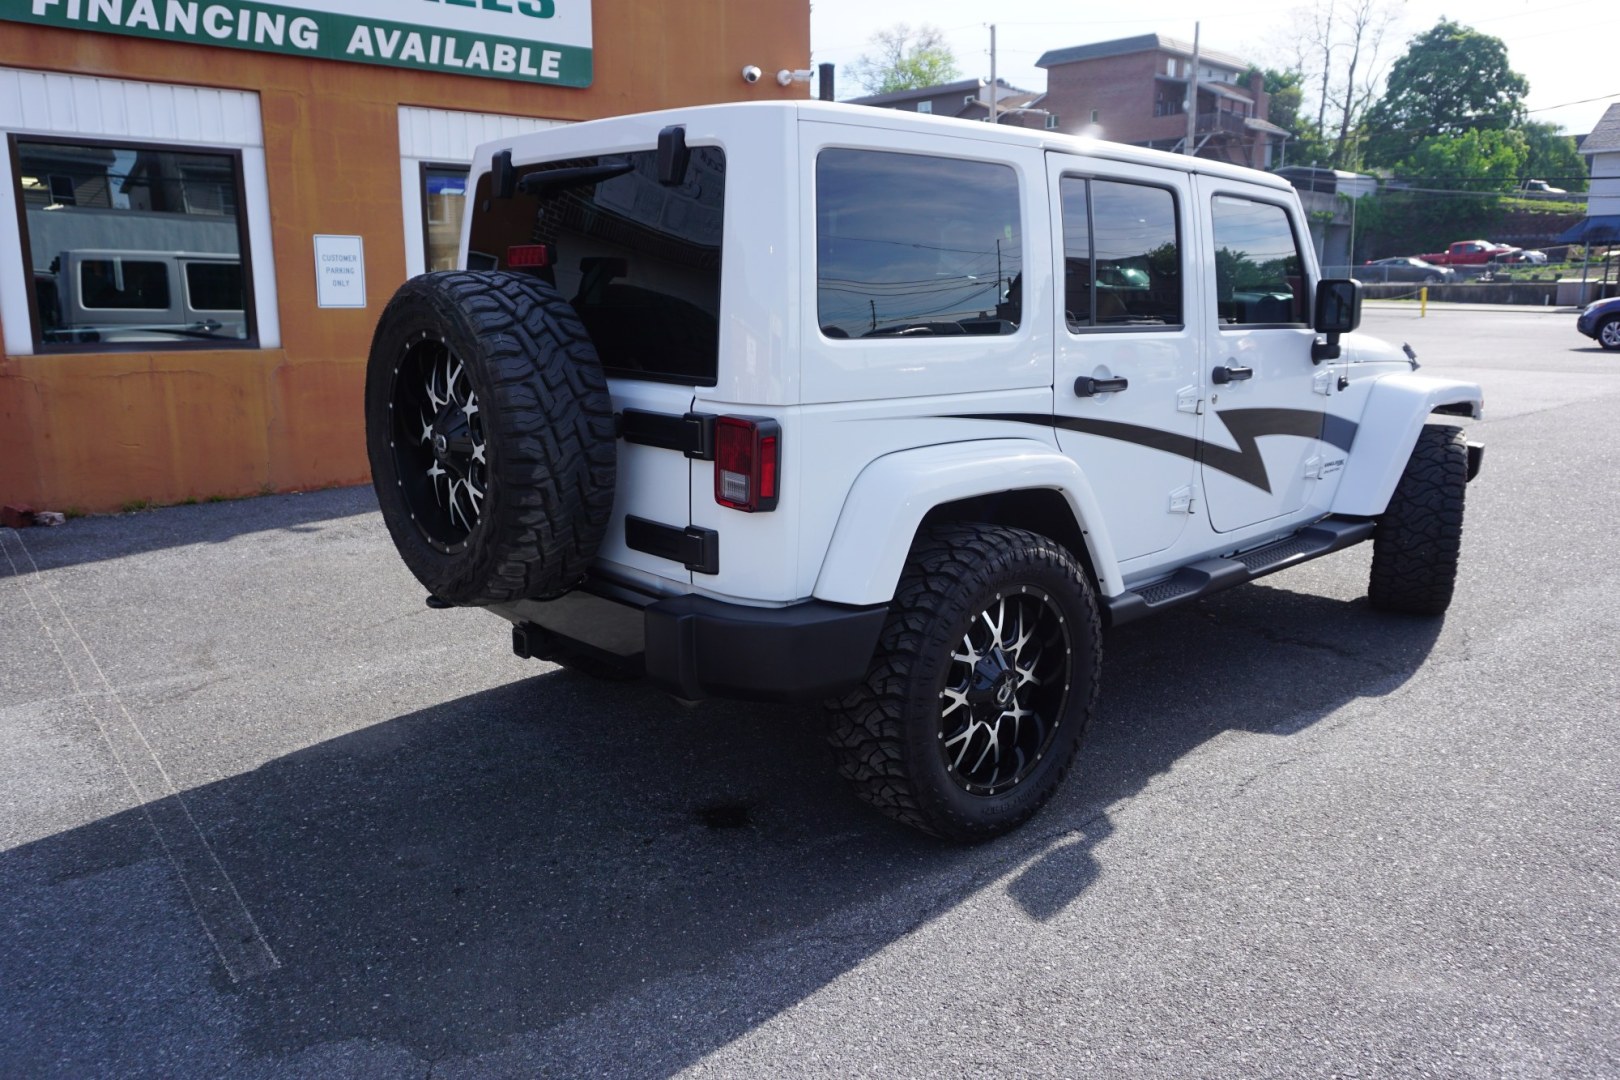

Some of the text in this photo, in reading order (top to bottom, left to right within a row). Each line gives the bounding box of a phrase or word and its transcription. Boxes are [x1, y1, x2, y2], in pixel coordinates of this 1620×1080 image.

[346, 25, 562, 78] AVAILABLE
[321, 254, 357, 262] CUSTOMER
[325, 266, 355, 274] PARKING
